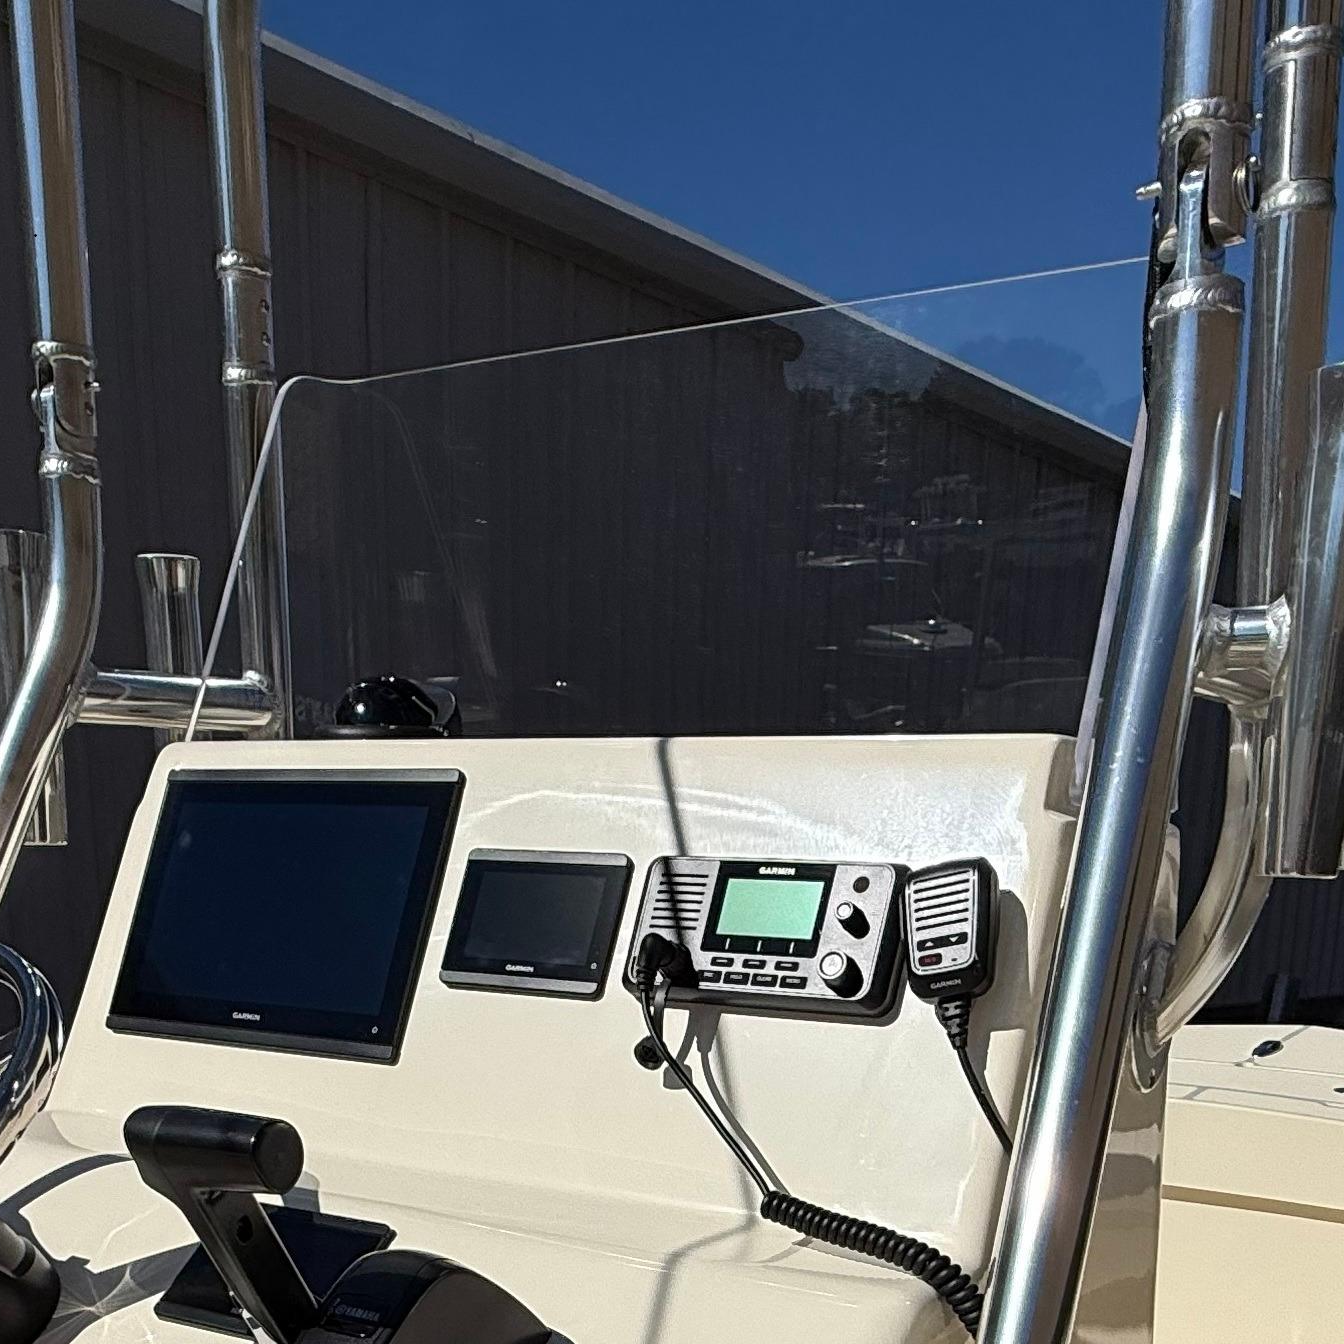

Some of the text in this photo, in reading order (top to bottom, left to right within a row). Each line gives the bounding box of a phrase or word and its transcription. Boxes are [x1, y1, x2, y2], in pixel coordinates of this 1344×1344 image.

[758, 866, 796, 876] GARMIN
[505, 964, 534, 973] GARMIN
[930, 978, 962, 990] GARMIN
[232, 1011, 261, 1022] GARMIN
